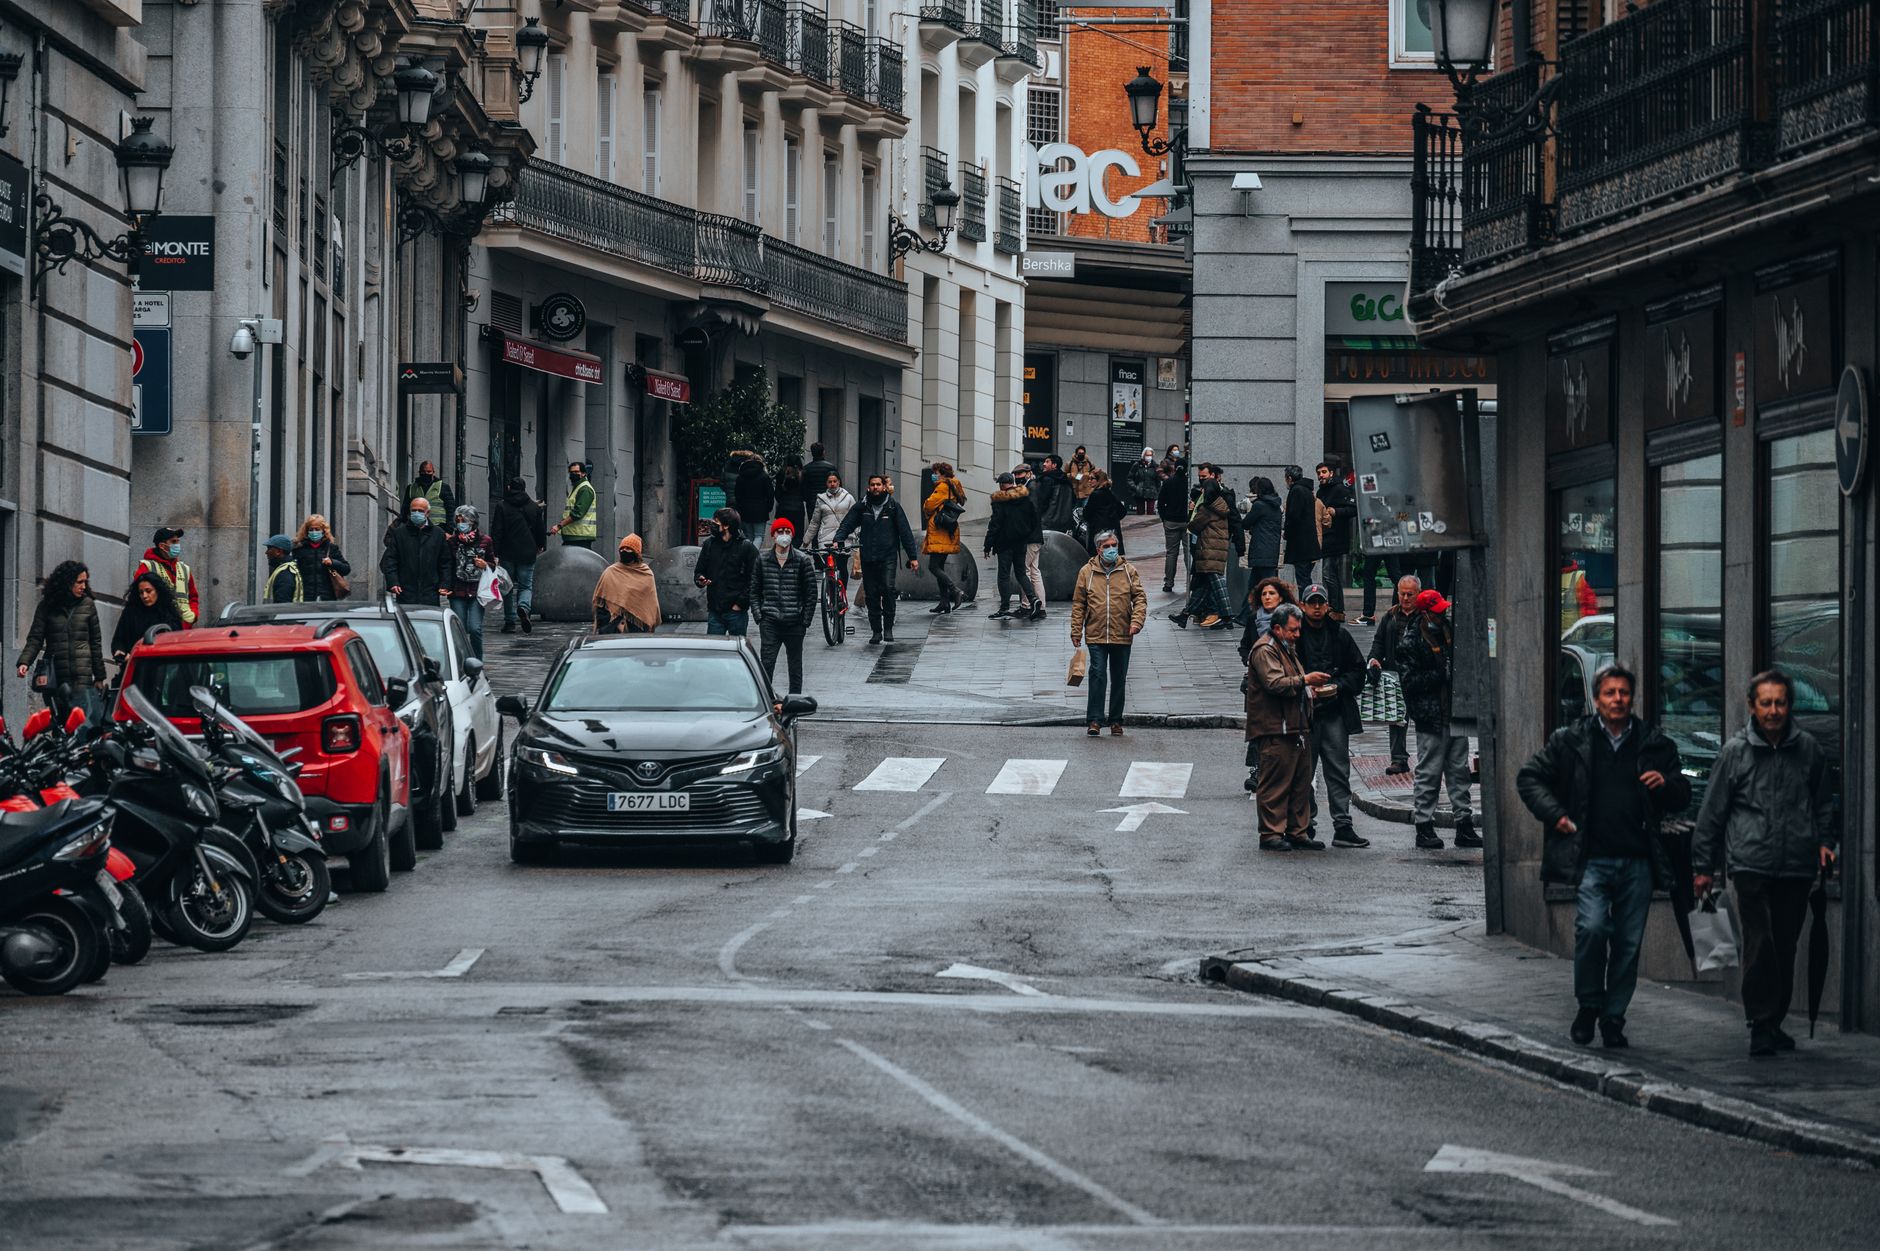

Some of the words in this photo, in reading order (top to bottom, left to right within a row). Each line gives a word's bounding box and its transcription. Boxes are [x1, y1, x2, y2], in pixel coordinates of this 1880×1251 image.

[1022, 258, 1072, 271] Bershka
[1118, 369, 1137, 380] fnac
[1028, 426, 1050, 440] FNAC
[618, 796, 654, 808] 7677
[659, 796, 686, 808] LDC
